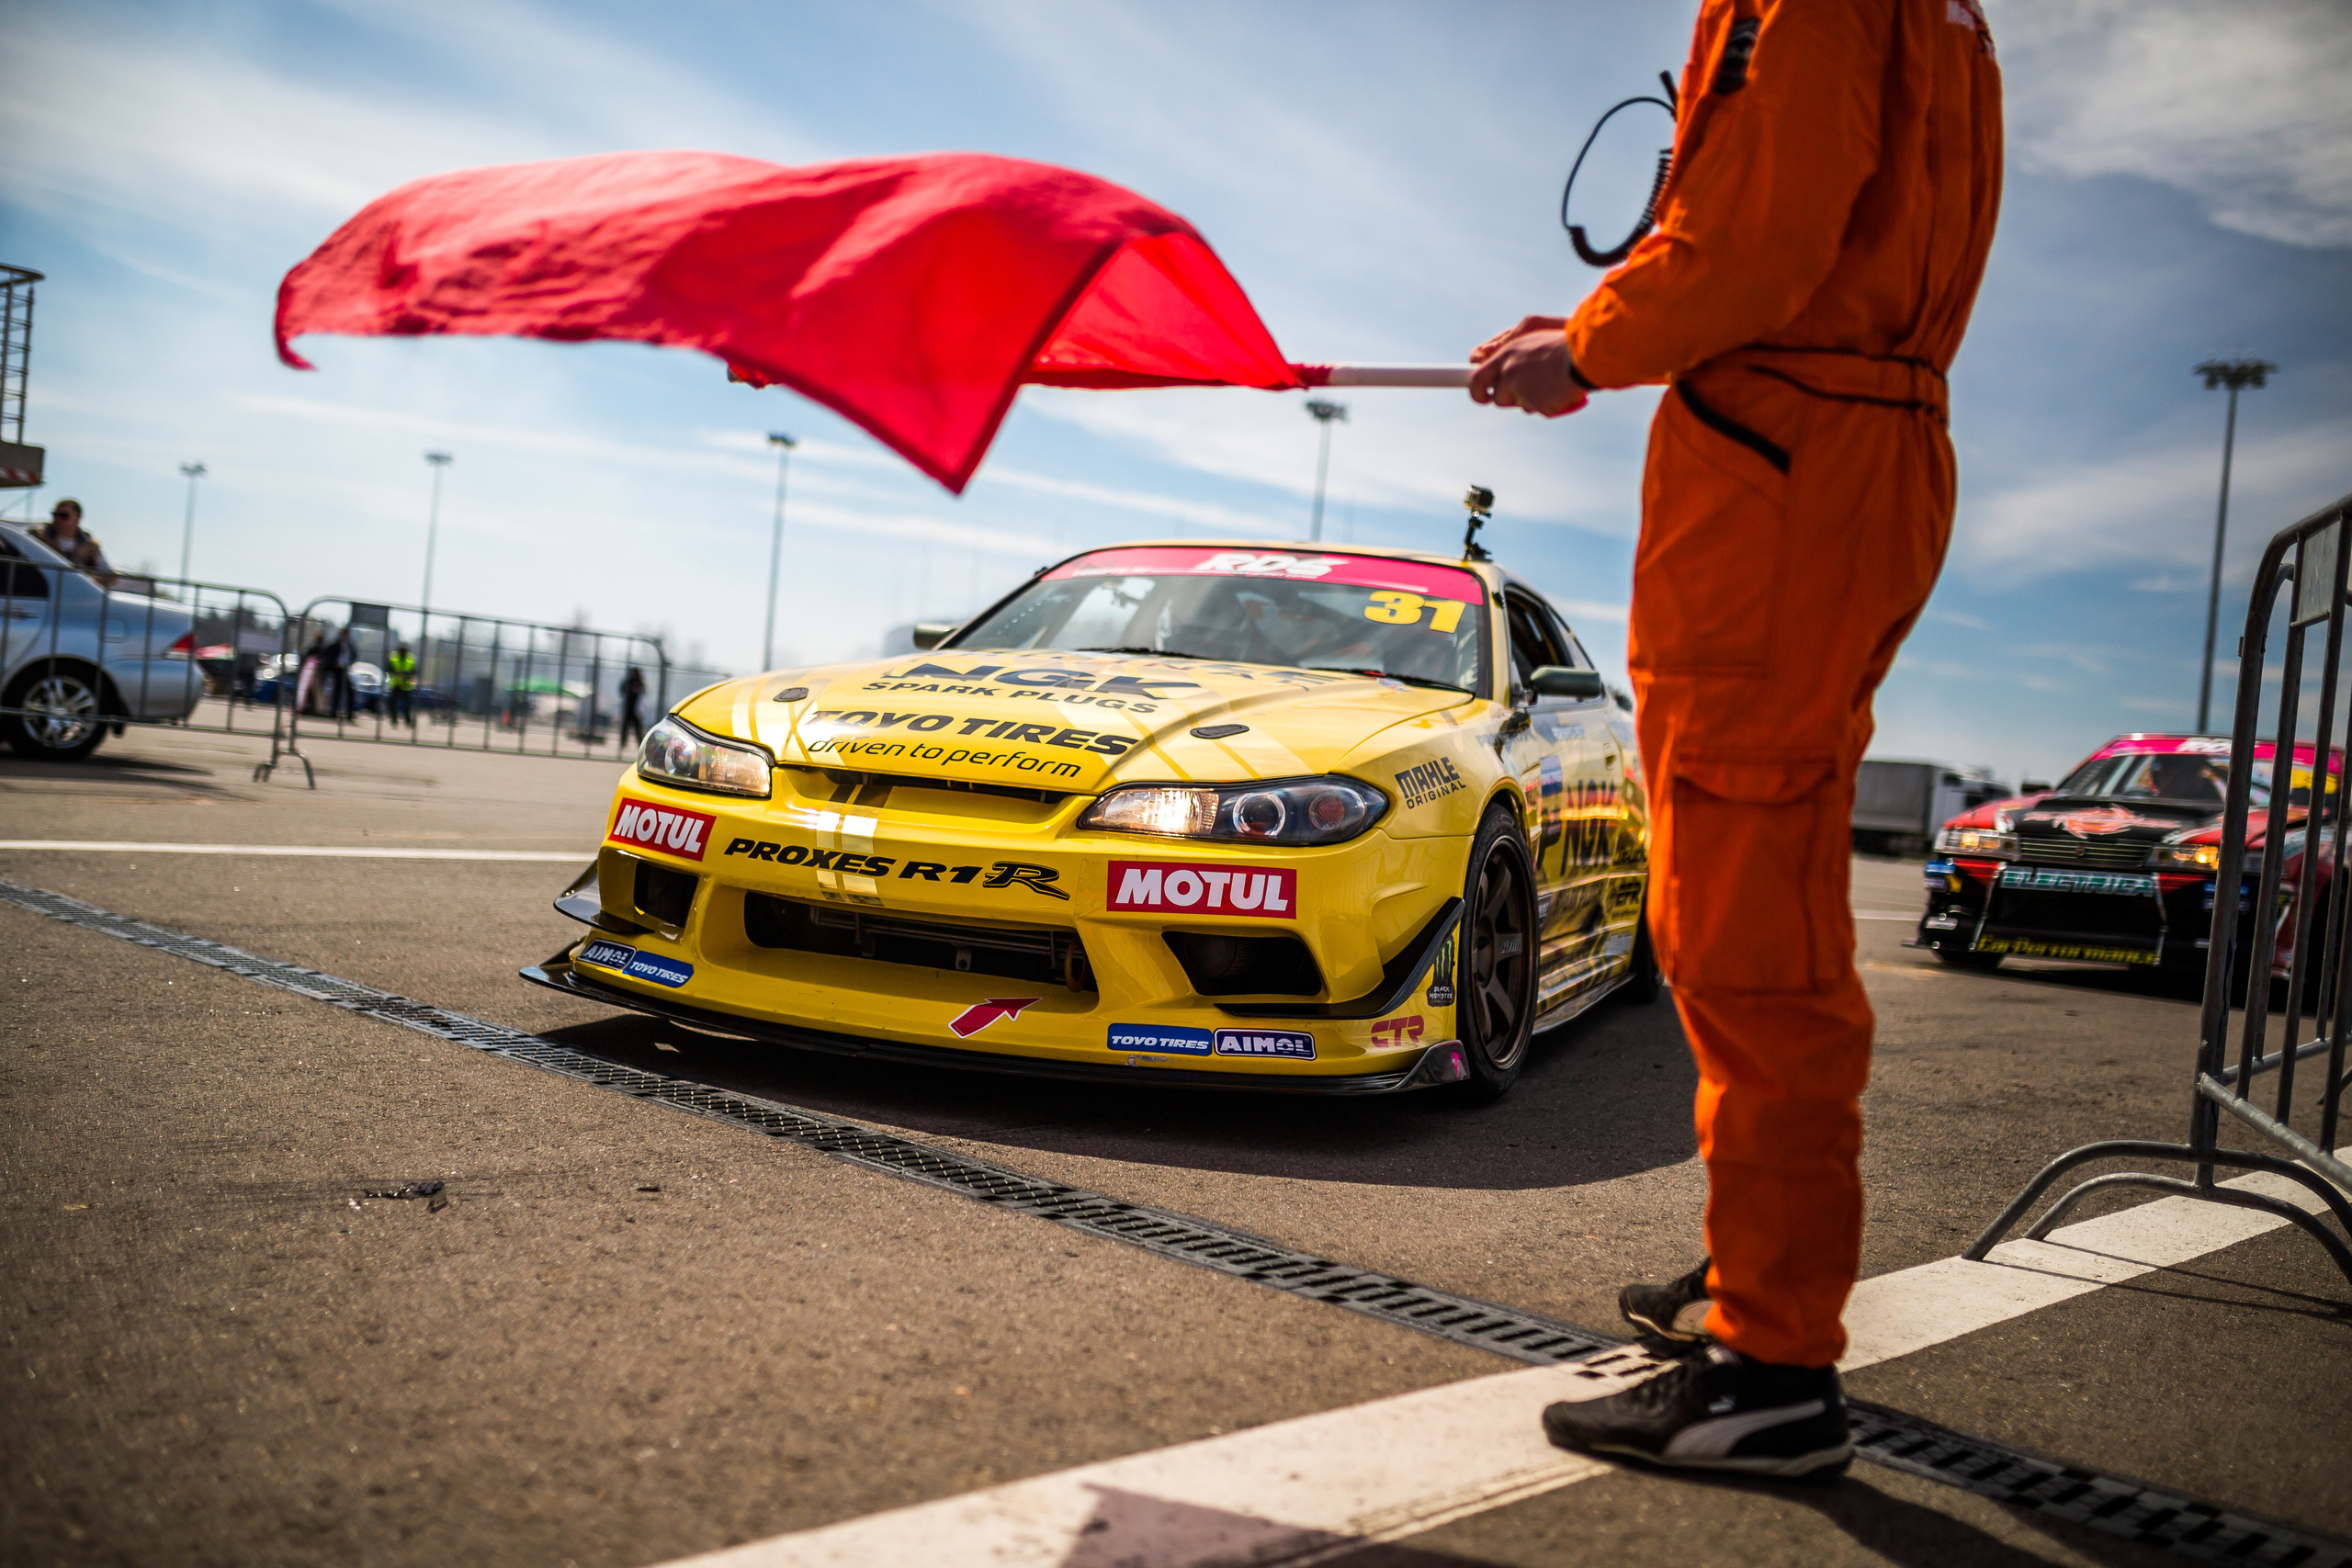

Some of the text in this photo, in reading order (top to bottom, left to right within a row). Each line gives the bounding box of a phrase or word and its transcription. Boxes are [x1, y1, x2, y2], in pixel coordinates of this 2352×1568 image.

[1194, 552, 1351, 577] RDS
[1363, 591, 1466, 634] 31
[879, 662, 1203, 700] NGK
[862, 682, 1159, 714] SPARK PLUGS
[805, 710, 1142, 756] TOYO TIRES
[808, 736, 1082, 778] driven to perform
[1395, 757, 1461, 799] MAHLE
[1407, 780, 1466, 809] ORIGINAL
[614, 804, 705, 853] MOTUL
[724, 838, 897, 875] PROXES
[1114, 868, 1289, 911] MOTUL
[2002, 868, 2155, 897] ELECTRICA
[584, 944, 629, 965] AIMOL
[629, 960, 689, 985] TOYO TIRES
[1429, 992, 1453, 1000] MONSTER
[1111, 1035, 1210, 1051] TOYO TIRES
[1219, 1036, 1311, 1055] AIMOL
[1371, 1014, 1424, 1048] CTR
